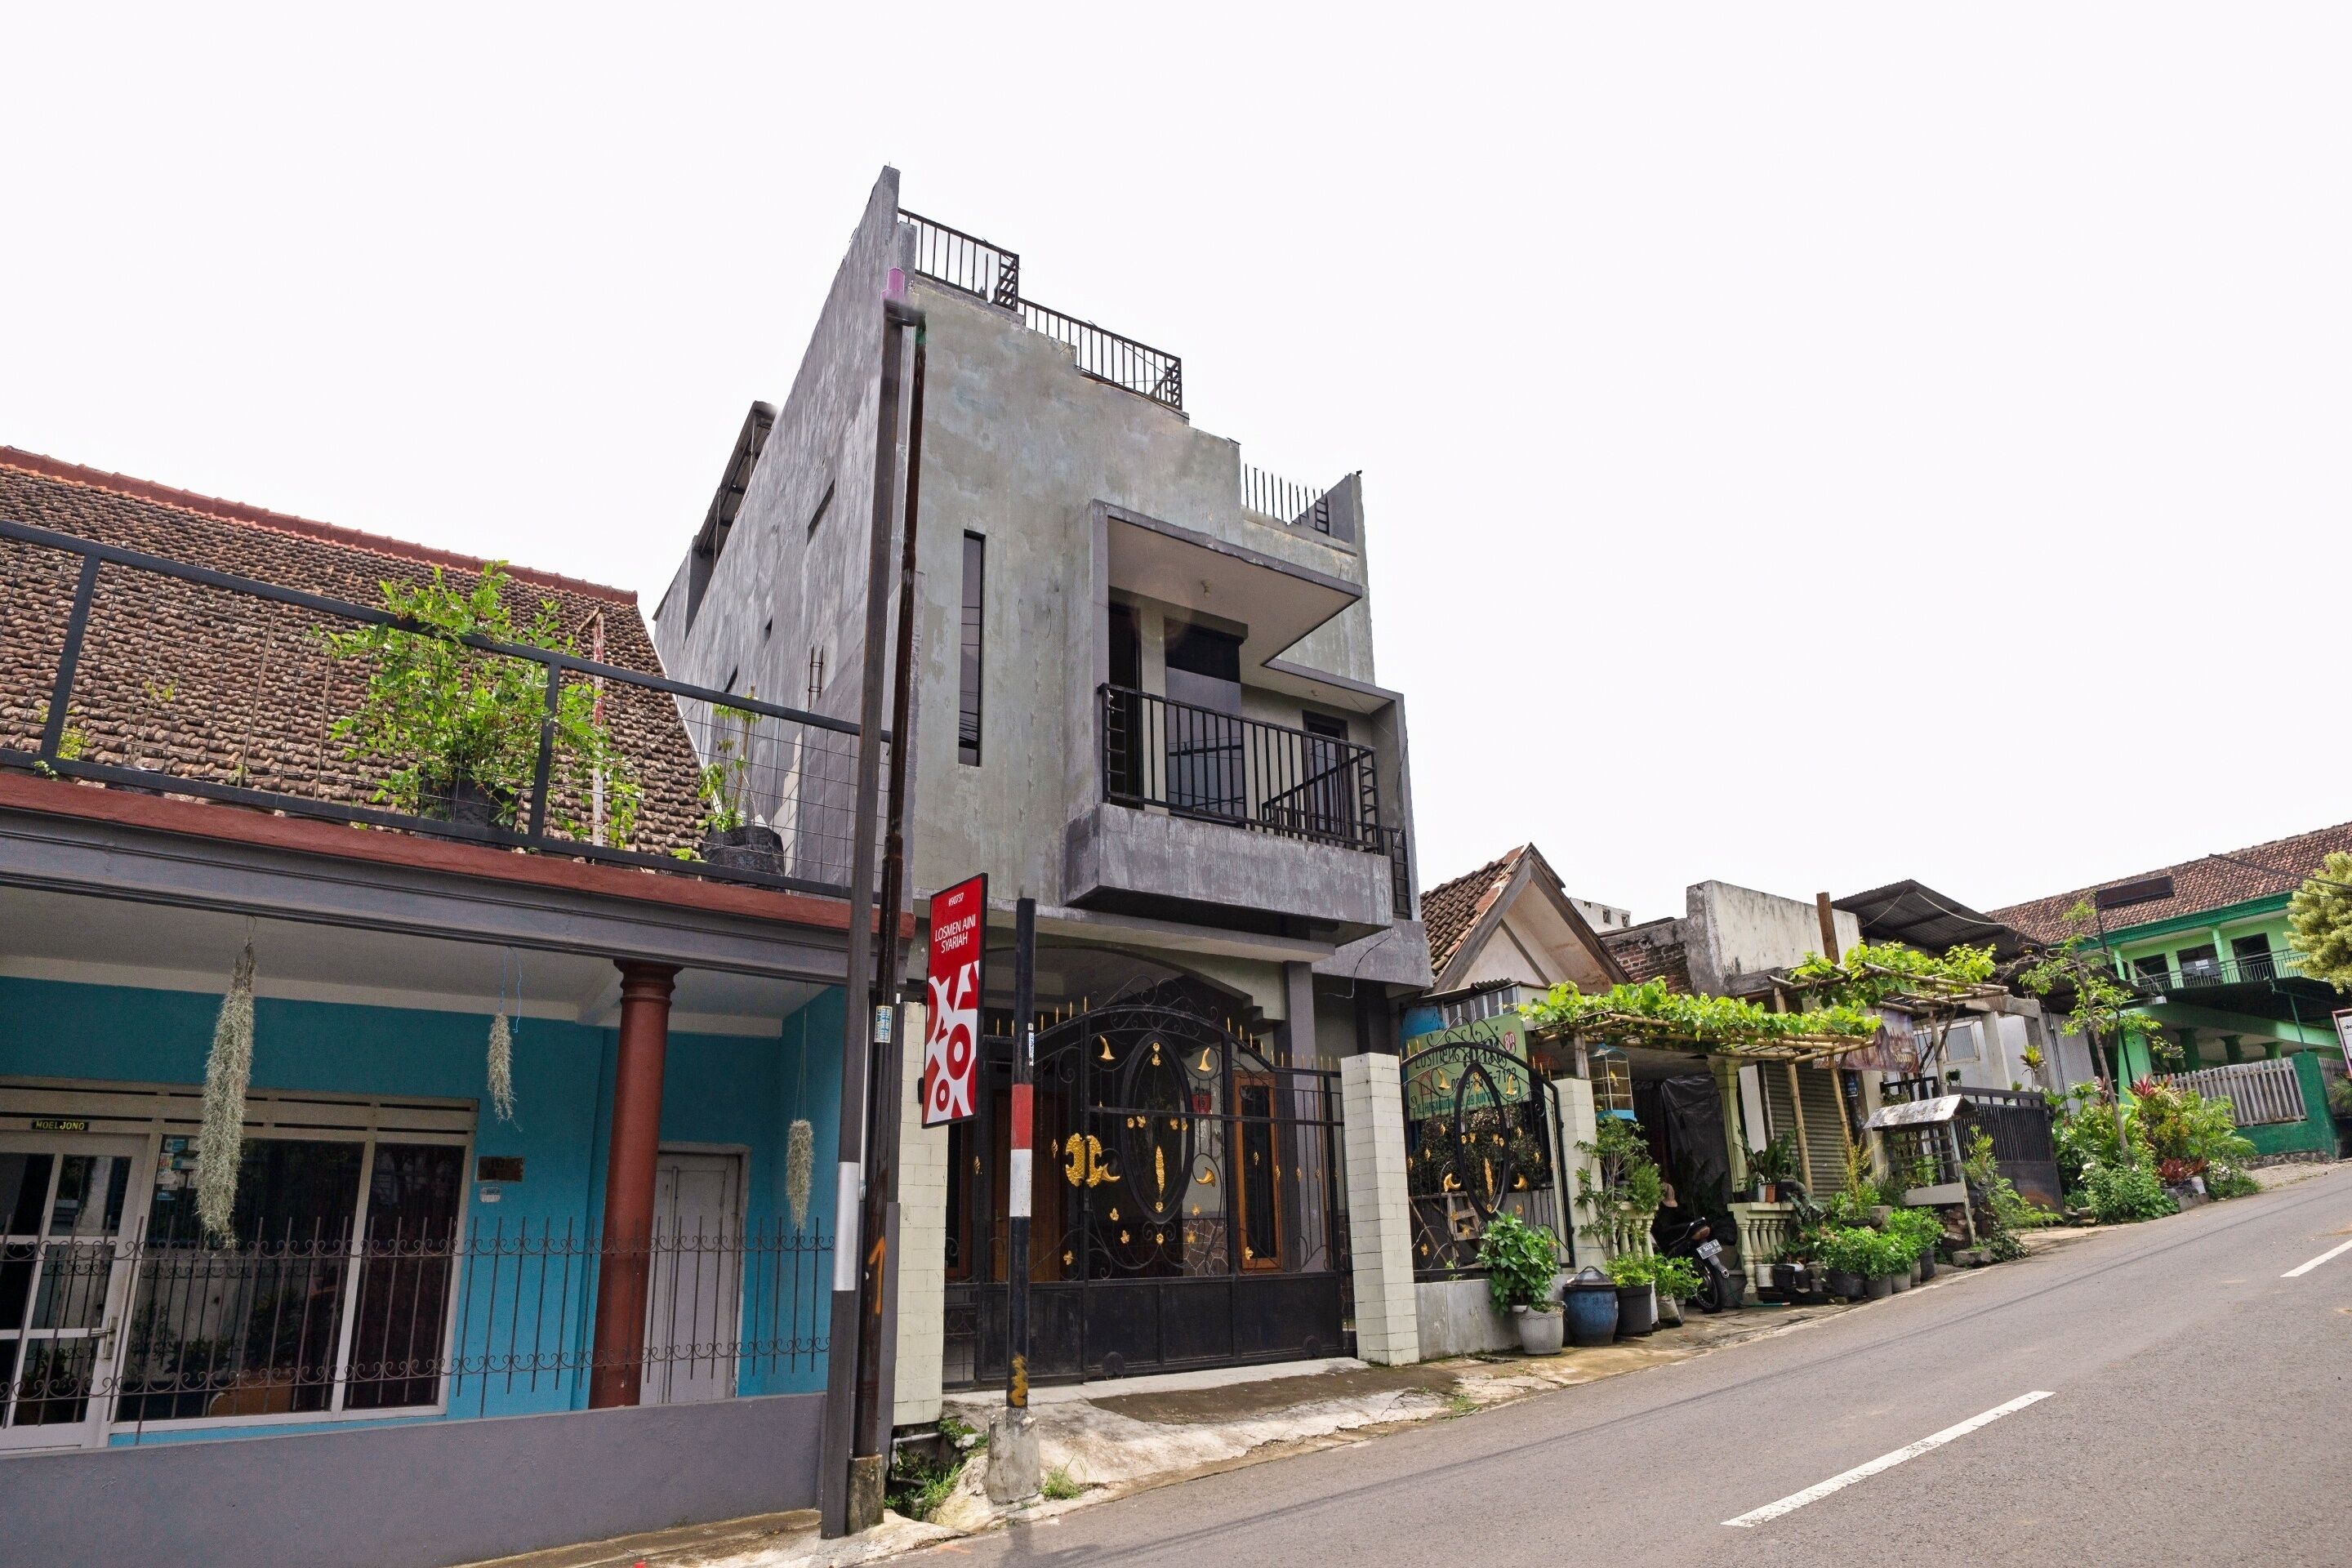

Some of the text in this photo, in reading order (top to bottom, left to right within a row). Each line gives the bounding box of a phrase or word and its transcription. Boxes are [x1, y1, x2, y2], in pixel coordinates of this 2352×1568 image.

[935, 914, 976, 942] LOSMEN AINI
[941, 932, 969, 954] SYARIAH
